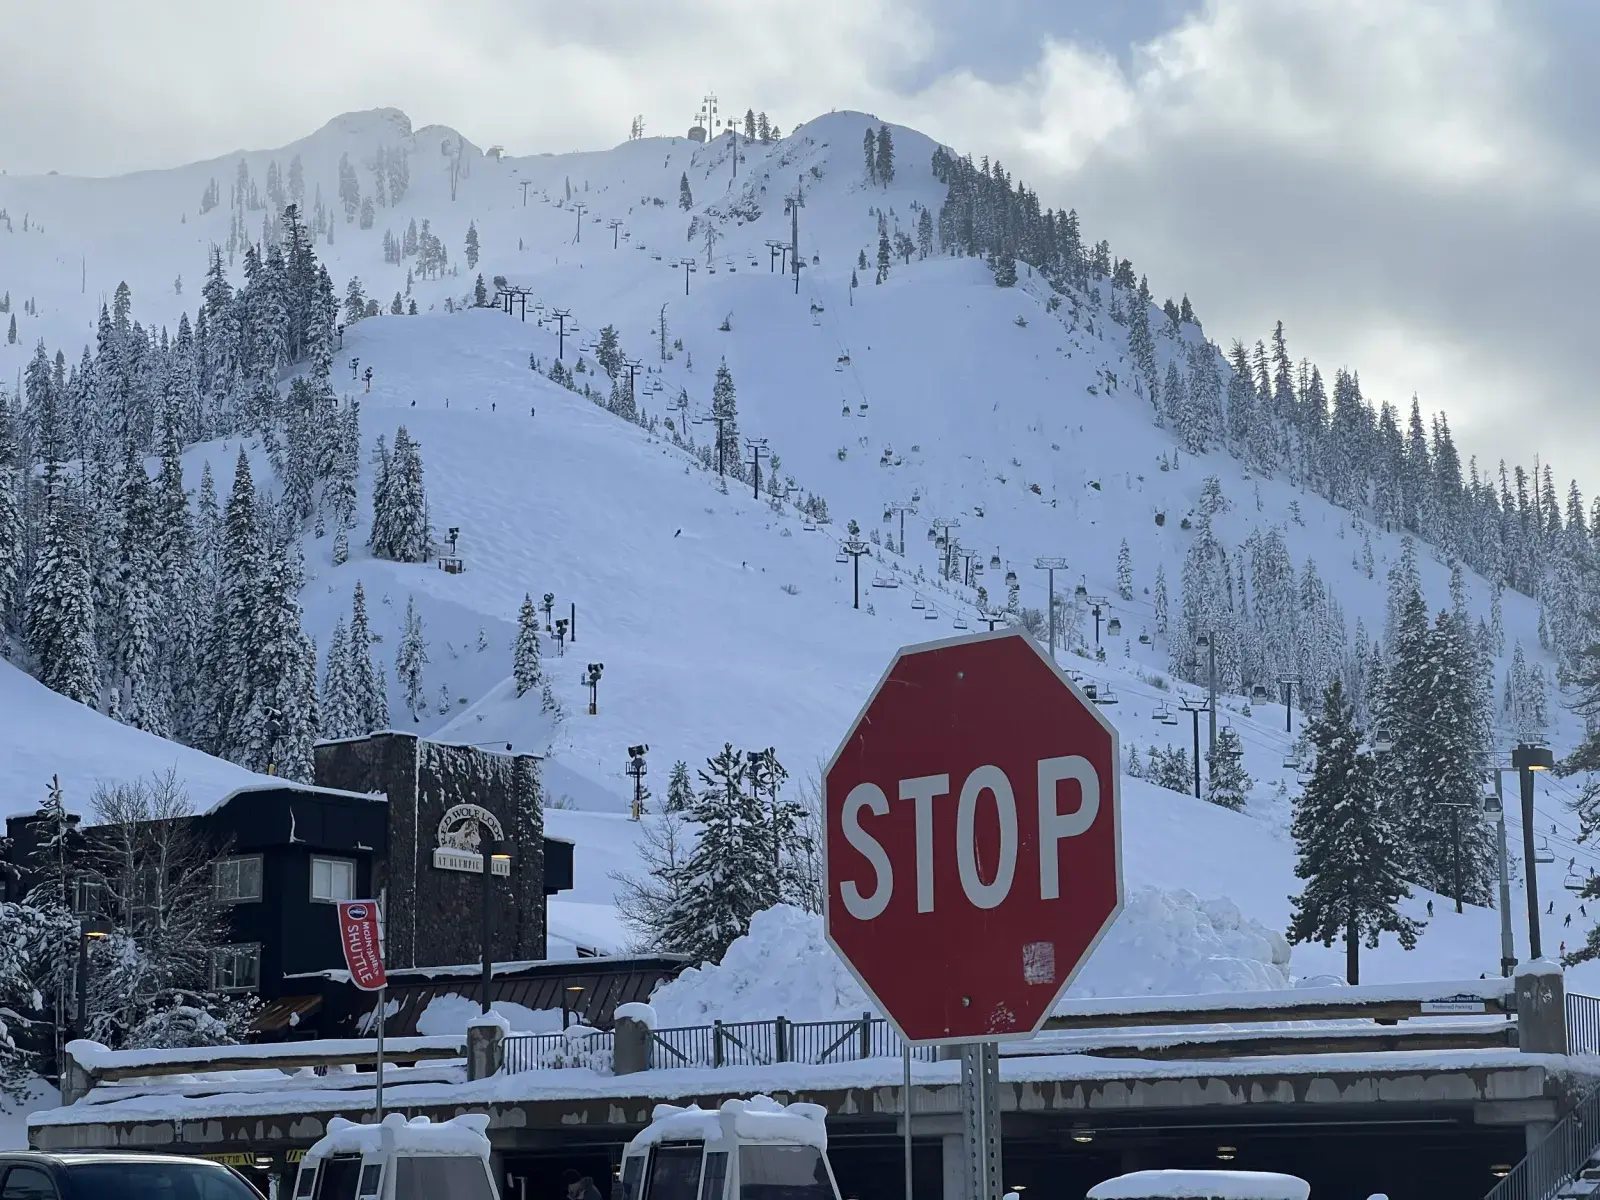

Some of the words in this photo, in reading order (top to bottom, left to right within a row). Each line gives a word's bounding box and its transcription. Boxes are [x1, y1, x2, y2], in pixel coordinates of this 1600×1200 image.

[440, 816, 452, 845] RED
[452, 808, 480, 818] WOLF
[481, 812, 503, 841] LODG
[840, 755, 1100, 920] STOP
[438, 856, 446, 867] AT
[449, 858, 480, 870] OLYMPIC
[492, 862, 508, 873] LLEY
[347, 924, 373, 984] SHUTTLE
